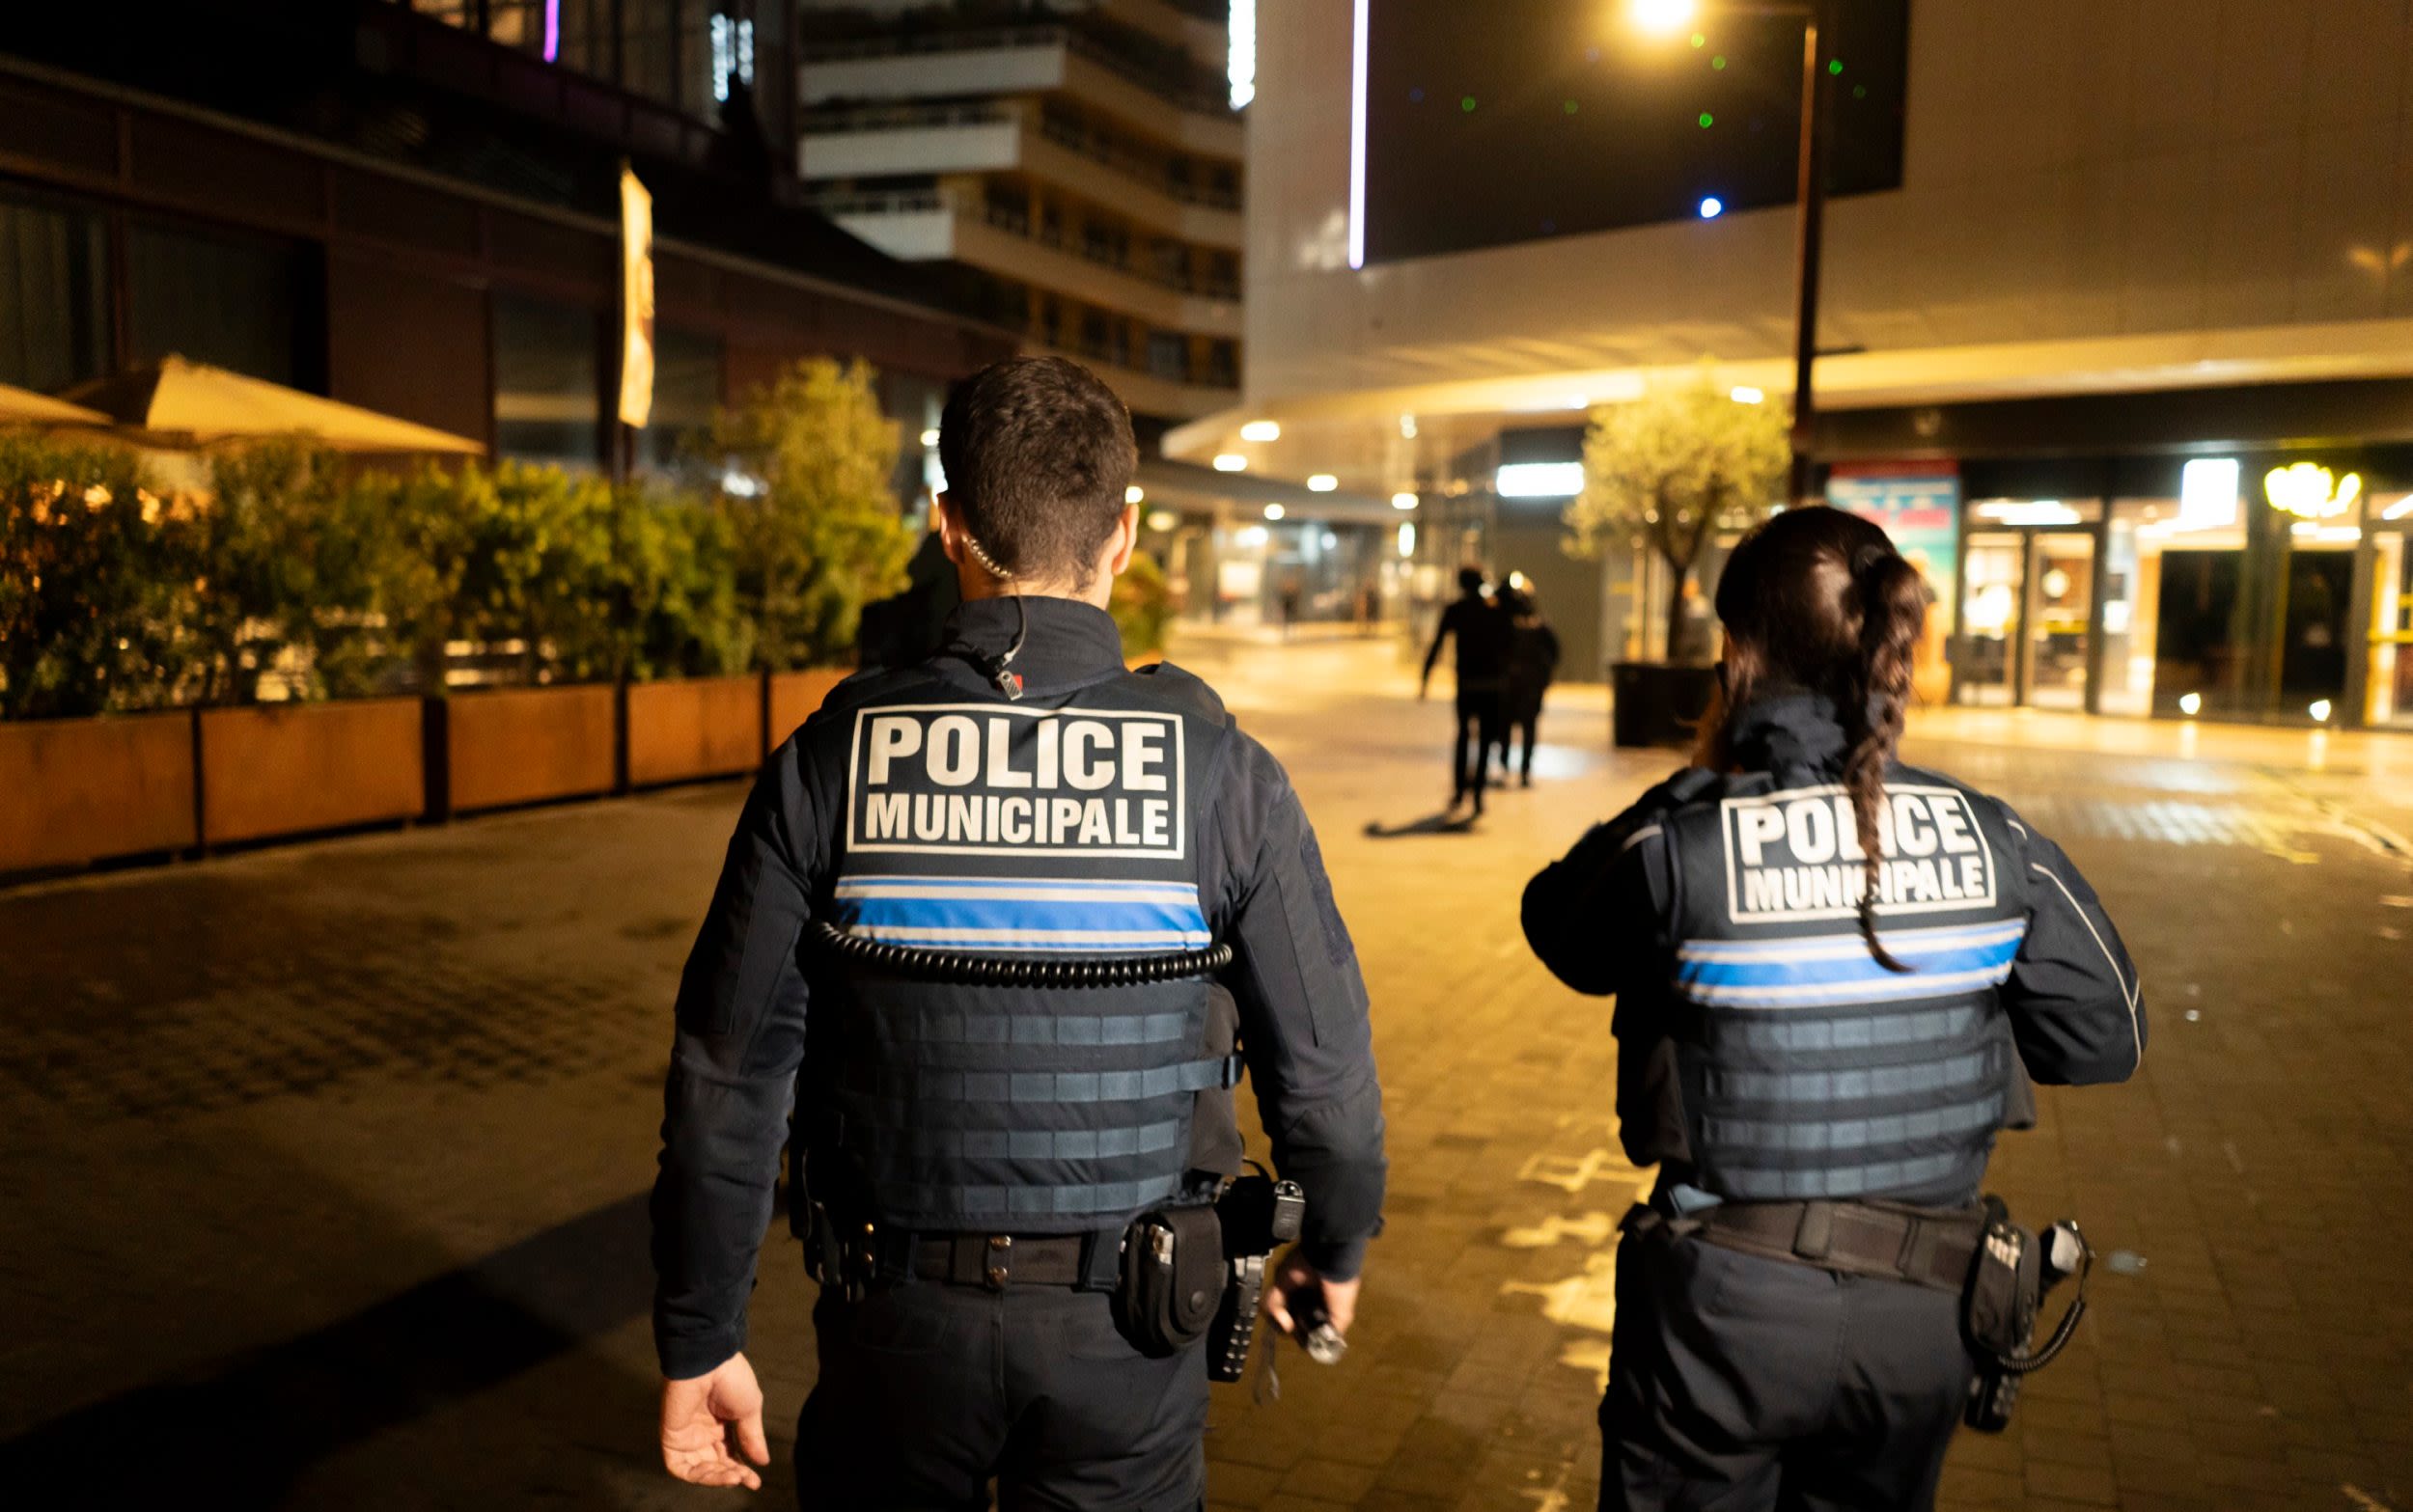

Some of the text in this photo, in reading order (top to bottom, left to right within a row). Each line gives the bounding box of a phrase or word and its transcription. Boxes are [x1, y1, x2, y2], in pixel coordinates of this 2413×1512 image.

[868, 715, 1168, 791] POLICE
[865, 792, 1169, 845] MUNICIPALE
[1736, 793, 1979, 866] POLICE
